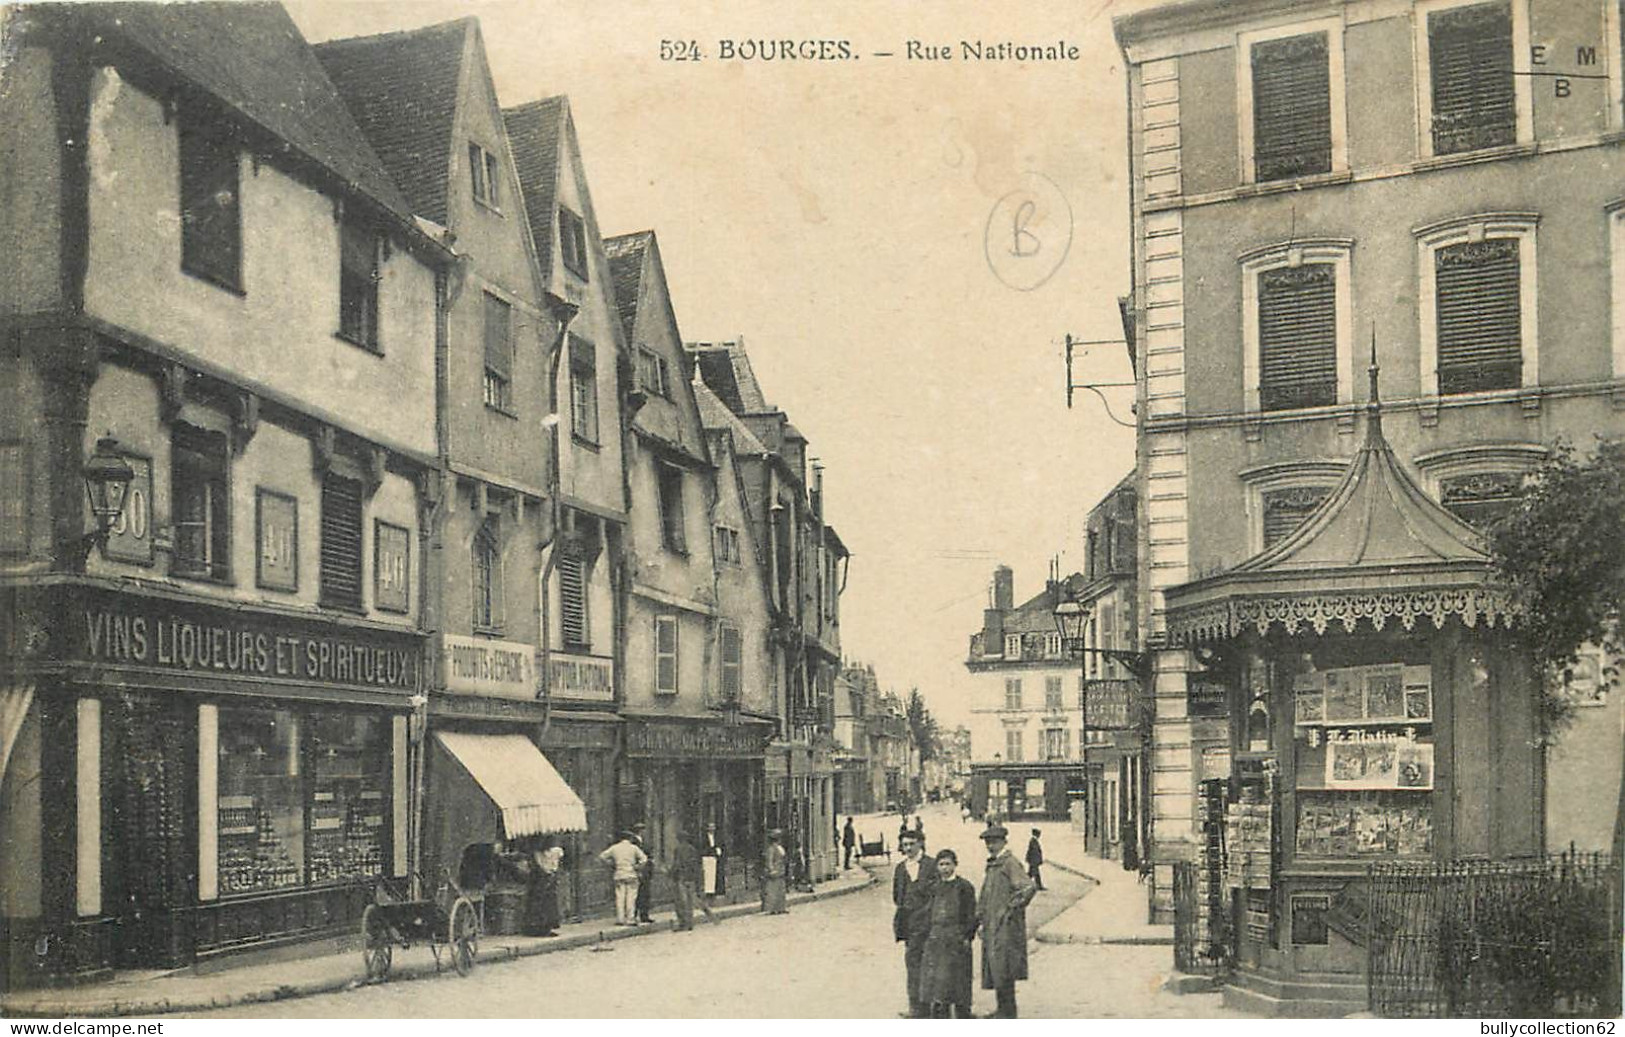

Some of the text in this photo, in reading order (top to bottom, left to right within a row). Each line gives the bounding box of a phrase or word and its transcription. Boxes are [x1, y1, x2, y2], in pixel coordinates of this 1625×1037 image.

[86, 611, 408, 686] VINS LIQUEURS ET SPIRITUEUX
